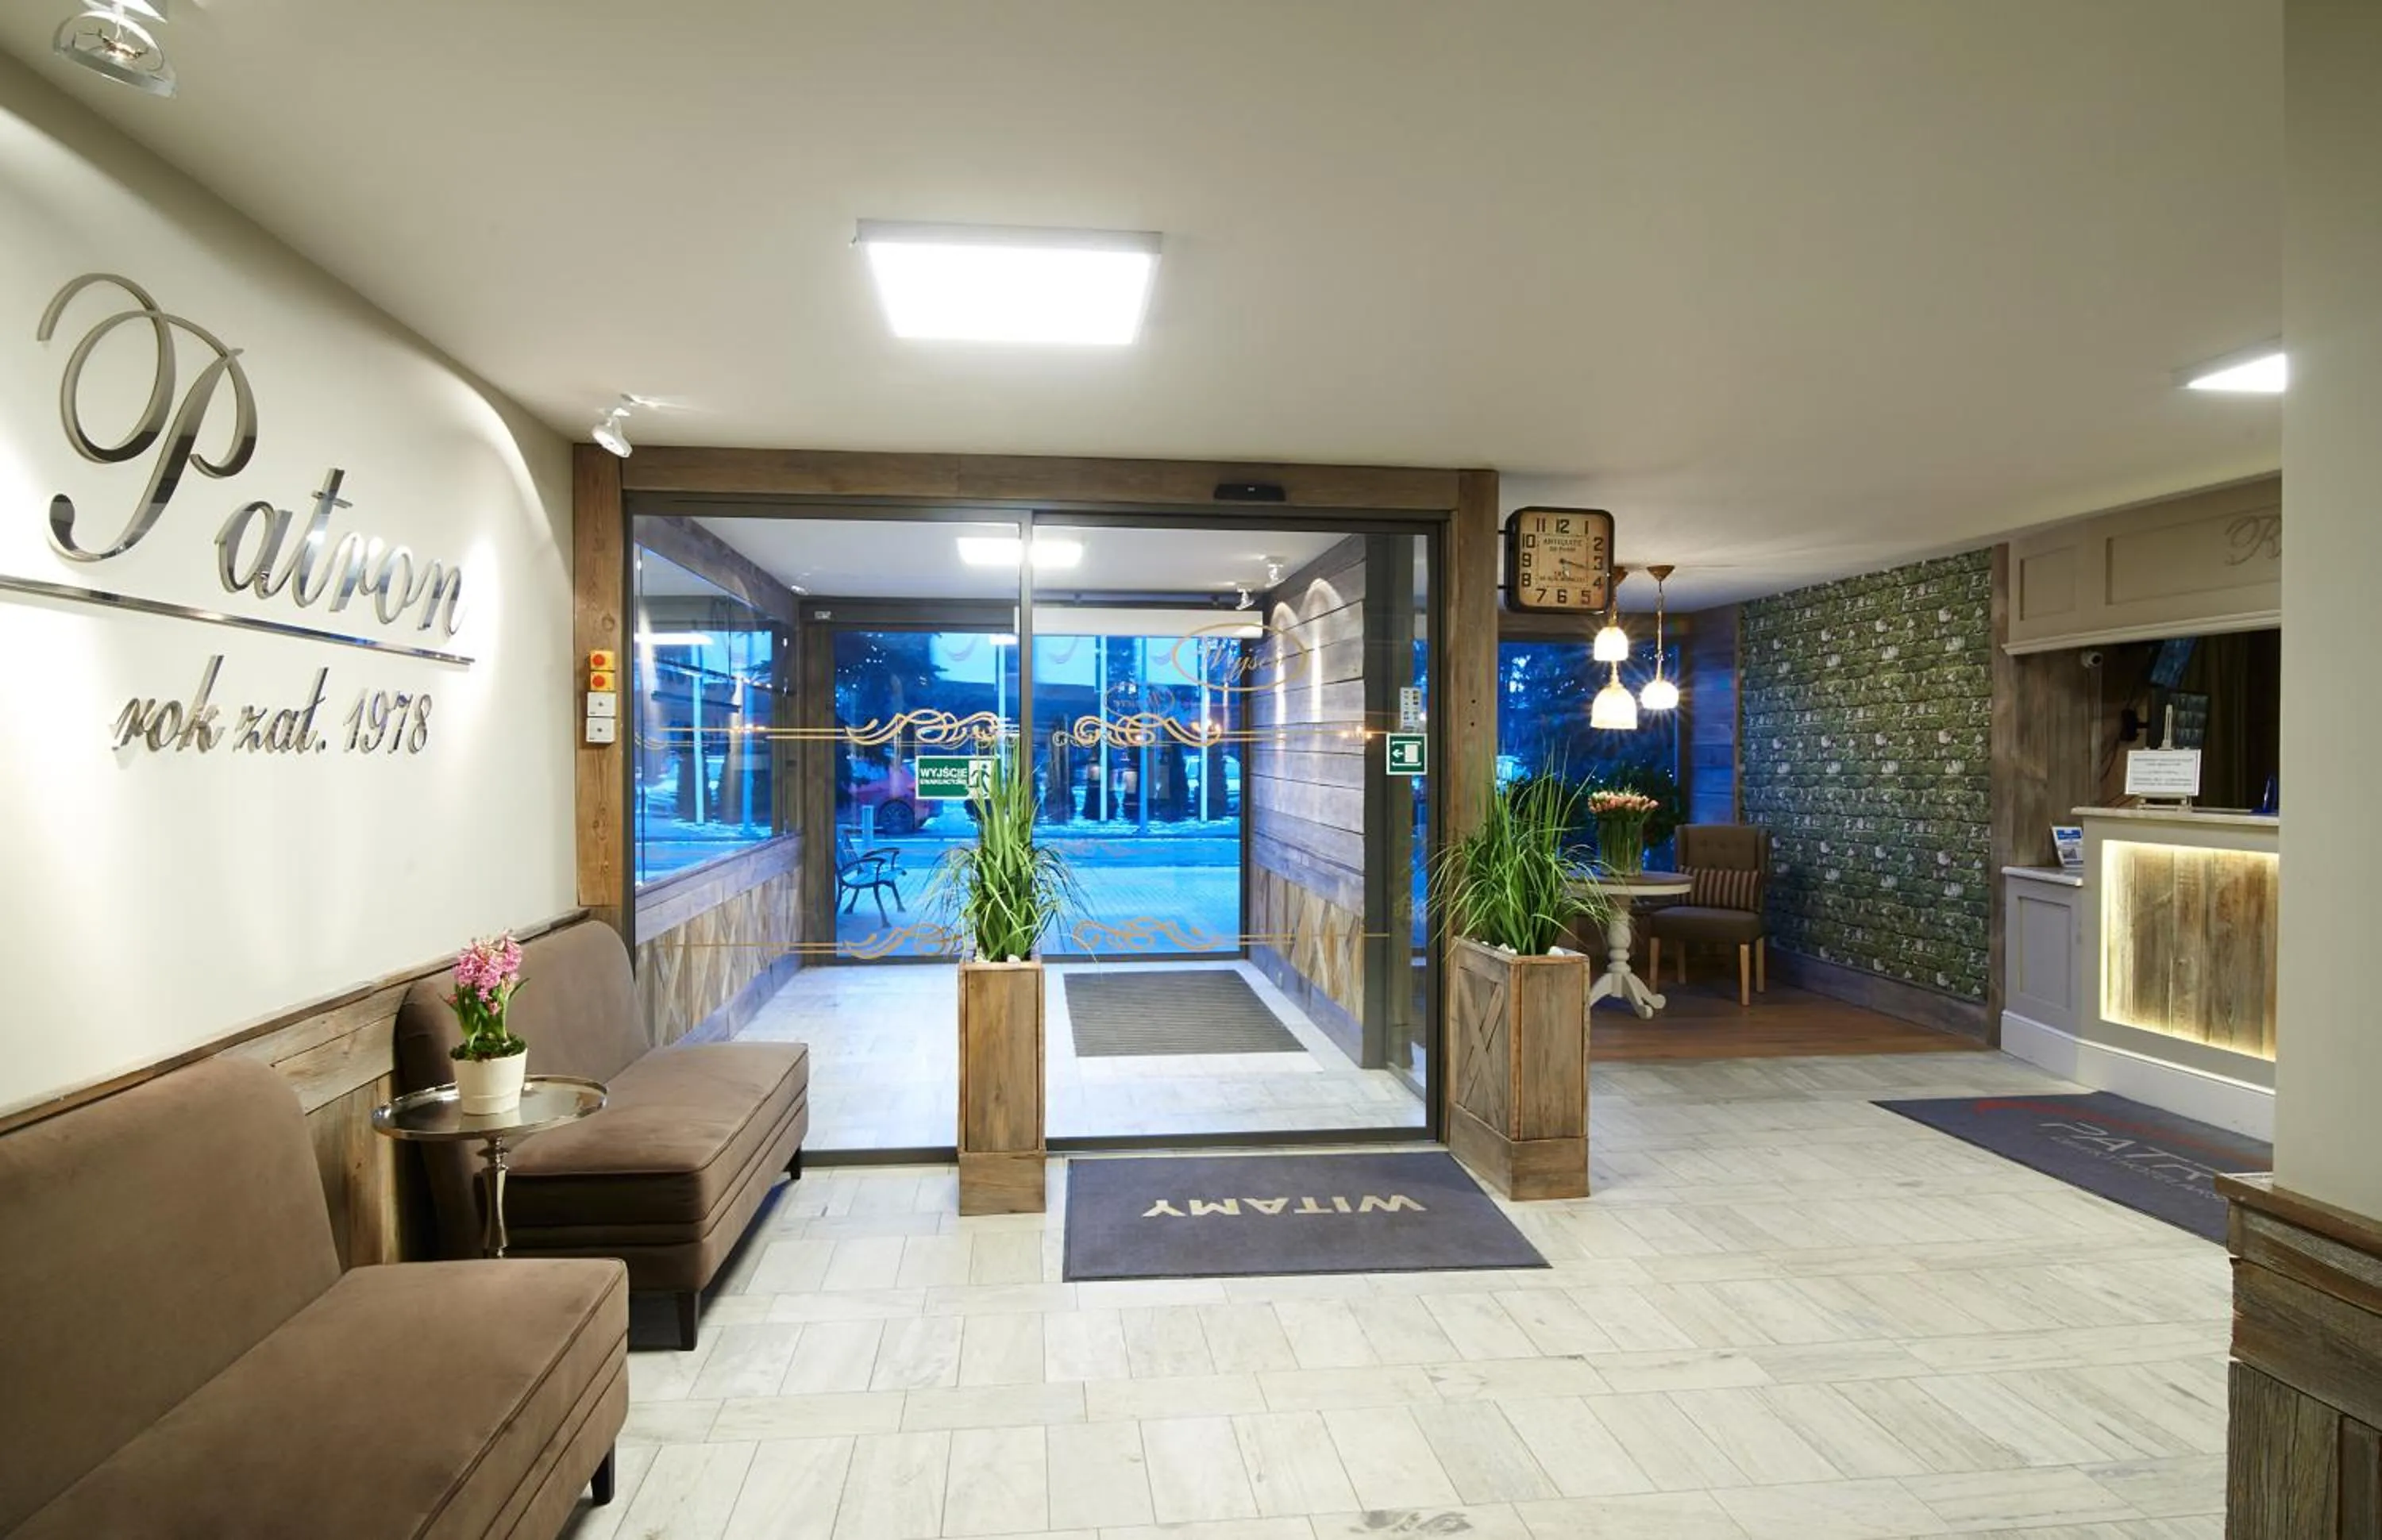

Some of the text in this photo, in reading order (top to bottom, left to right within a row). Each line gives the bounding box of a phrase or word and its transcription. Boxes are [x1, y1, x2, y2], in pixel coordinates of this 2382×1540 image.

[37, 272, 467, 636] Patron
[1536, 518, 1546, 533] 11
[1555, 518, 1570, 533] 12
[1522, 533, 1536, 548] 10
[1594, 537, 1603, 551] 2
[1522, 552, 1532, 567] 9
[1594, 556, 1603, 571] 3
[1521, 572, 1531, 587] 8
[1593, 577, 1602, 590] 4
[1536, 588, 1547, 603] 7
[1557, 589, 1567, 603] 6
[1581, 590, 1591, 604] 5
[110, 655, 225, 752] rok
[344, 688, 433, 754] 1978
[920, 765, 967, 778] WYJŚCIE
[1142, 1193, 1428, 1218] WITAMY
